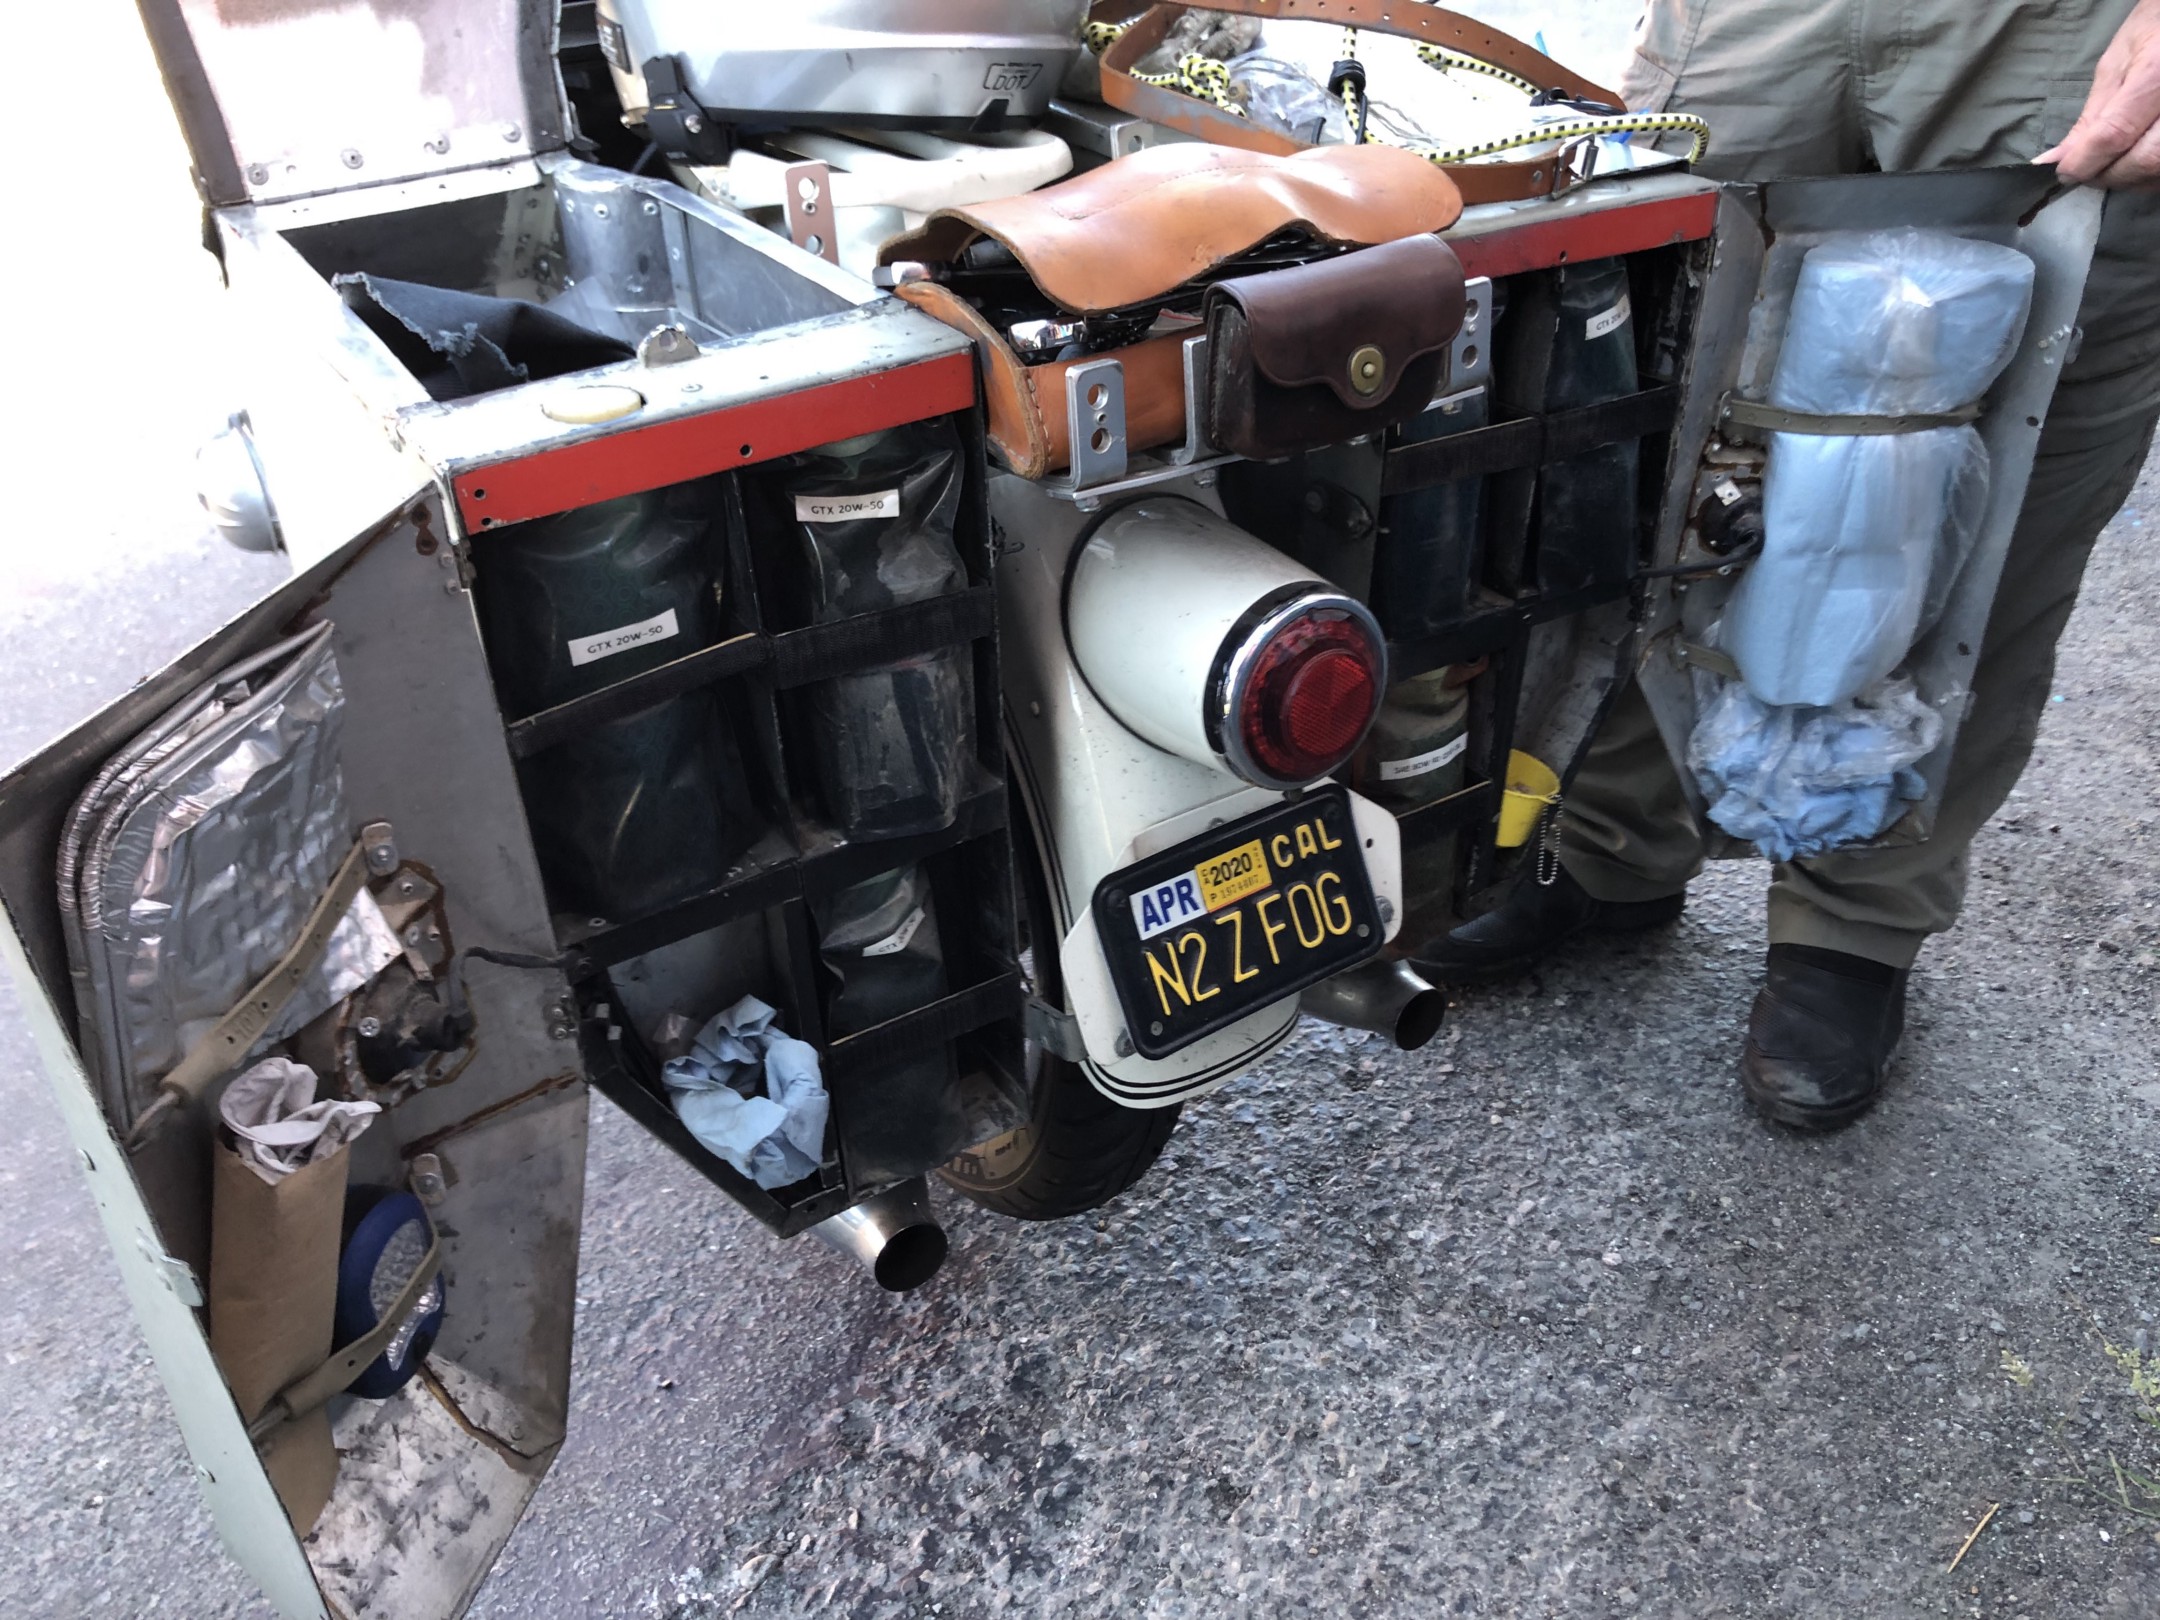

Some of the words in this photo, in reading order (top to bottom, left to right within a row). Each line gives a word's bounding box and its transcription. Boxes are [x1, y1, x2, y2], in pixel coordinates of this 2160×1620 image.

[992, 75, 1028, 90] DOT
[810, 504, 834, 516] GTX
[838, 500, 884, 514] 20W-50
[586, 641, 612, 655] GTX
[616, 625, 663, 647] 20W-50
[1271, 818, 1342, 868] CAL
[1210, 852, 1252, 887] 2020
[1143, 877, 1200, 933] APR
